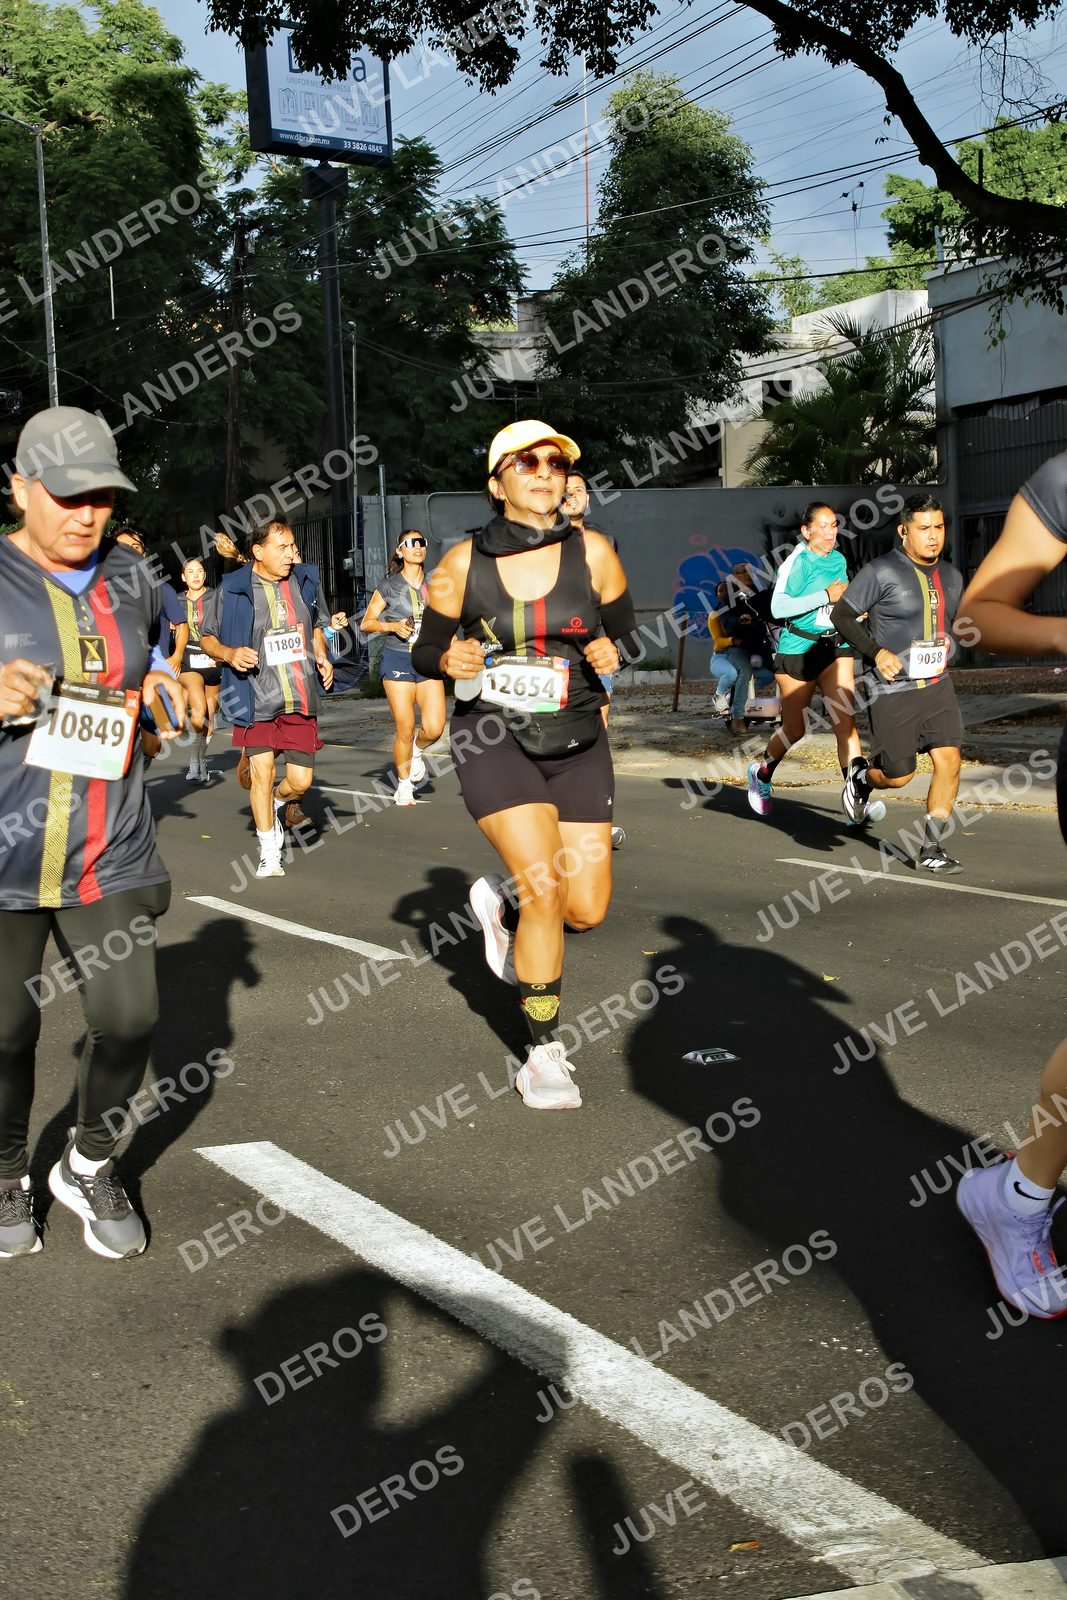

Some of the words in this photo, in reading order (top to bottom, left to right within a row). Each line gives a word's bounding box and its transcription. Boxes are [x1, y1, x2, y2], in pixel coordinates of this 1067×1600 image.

[343, 140, 352, 148] 33
[352, 141, 367, 151] 3826
[367, 143, 383, 153] 4845
[267, 636, 301, 652] 11809
[916, 651, 943, 665] 9058
[486, 672, 556, 698] 12654
[47, 707, 125, 747] 10849
